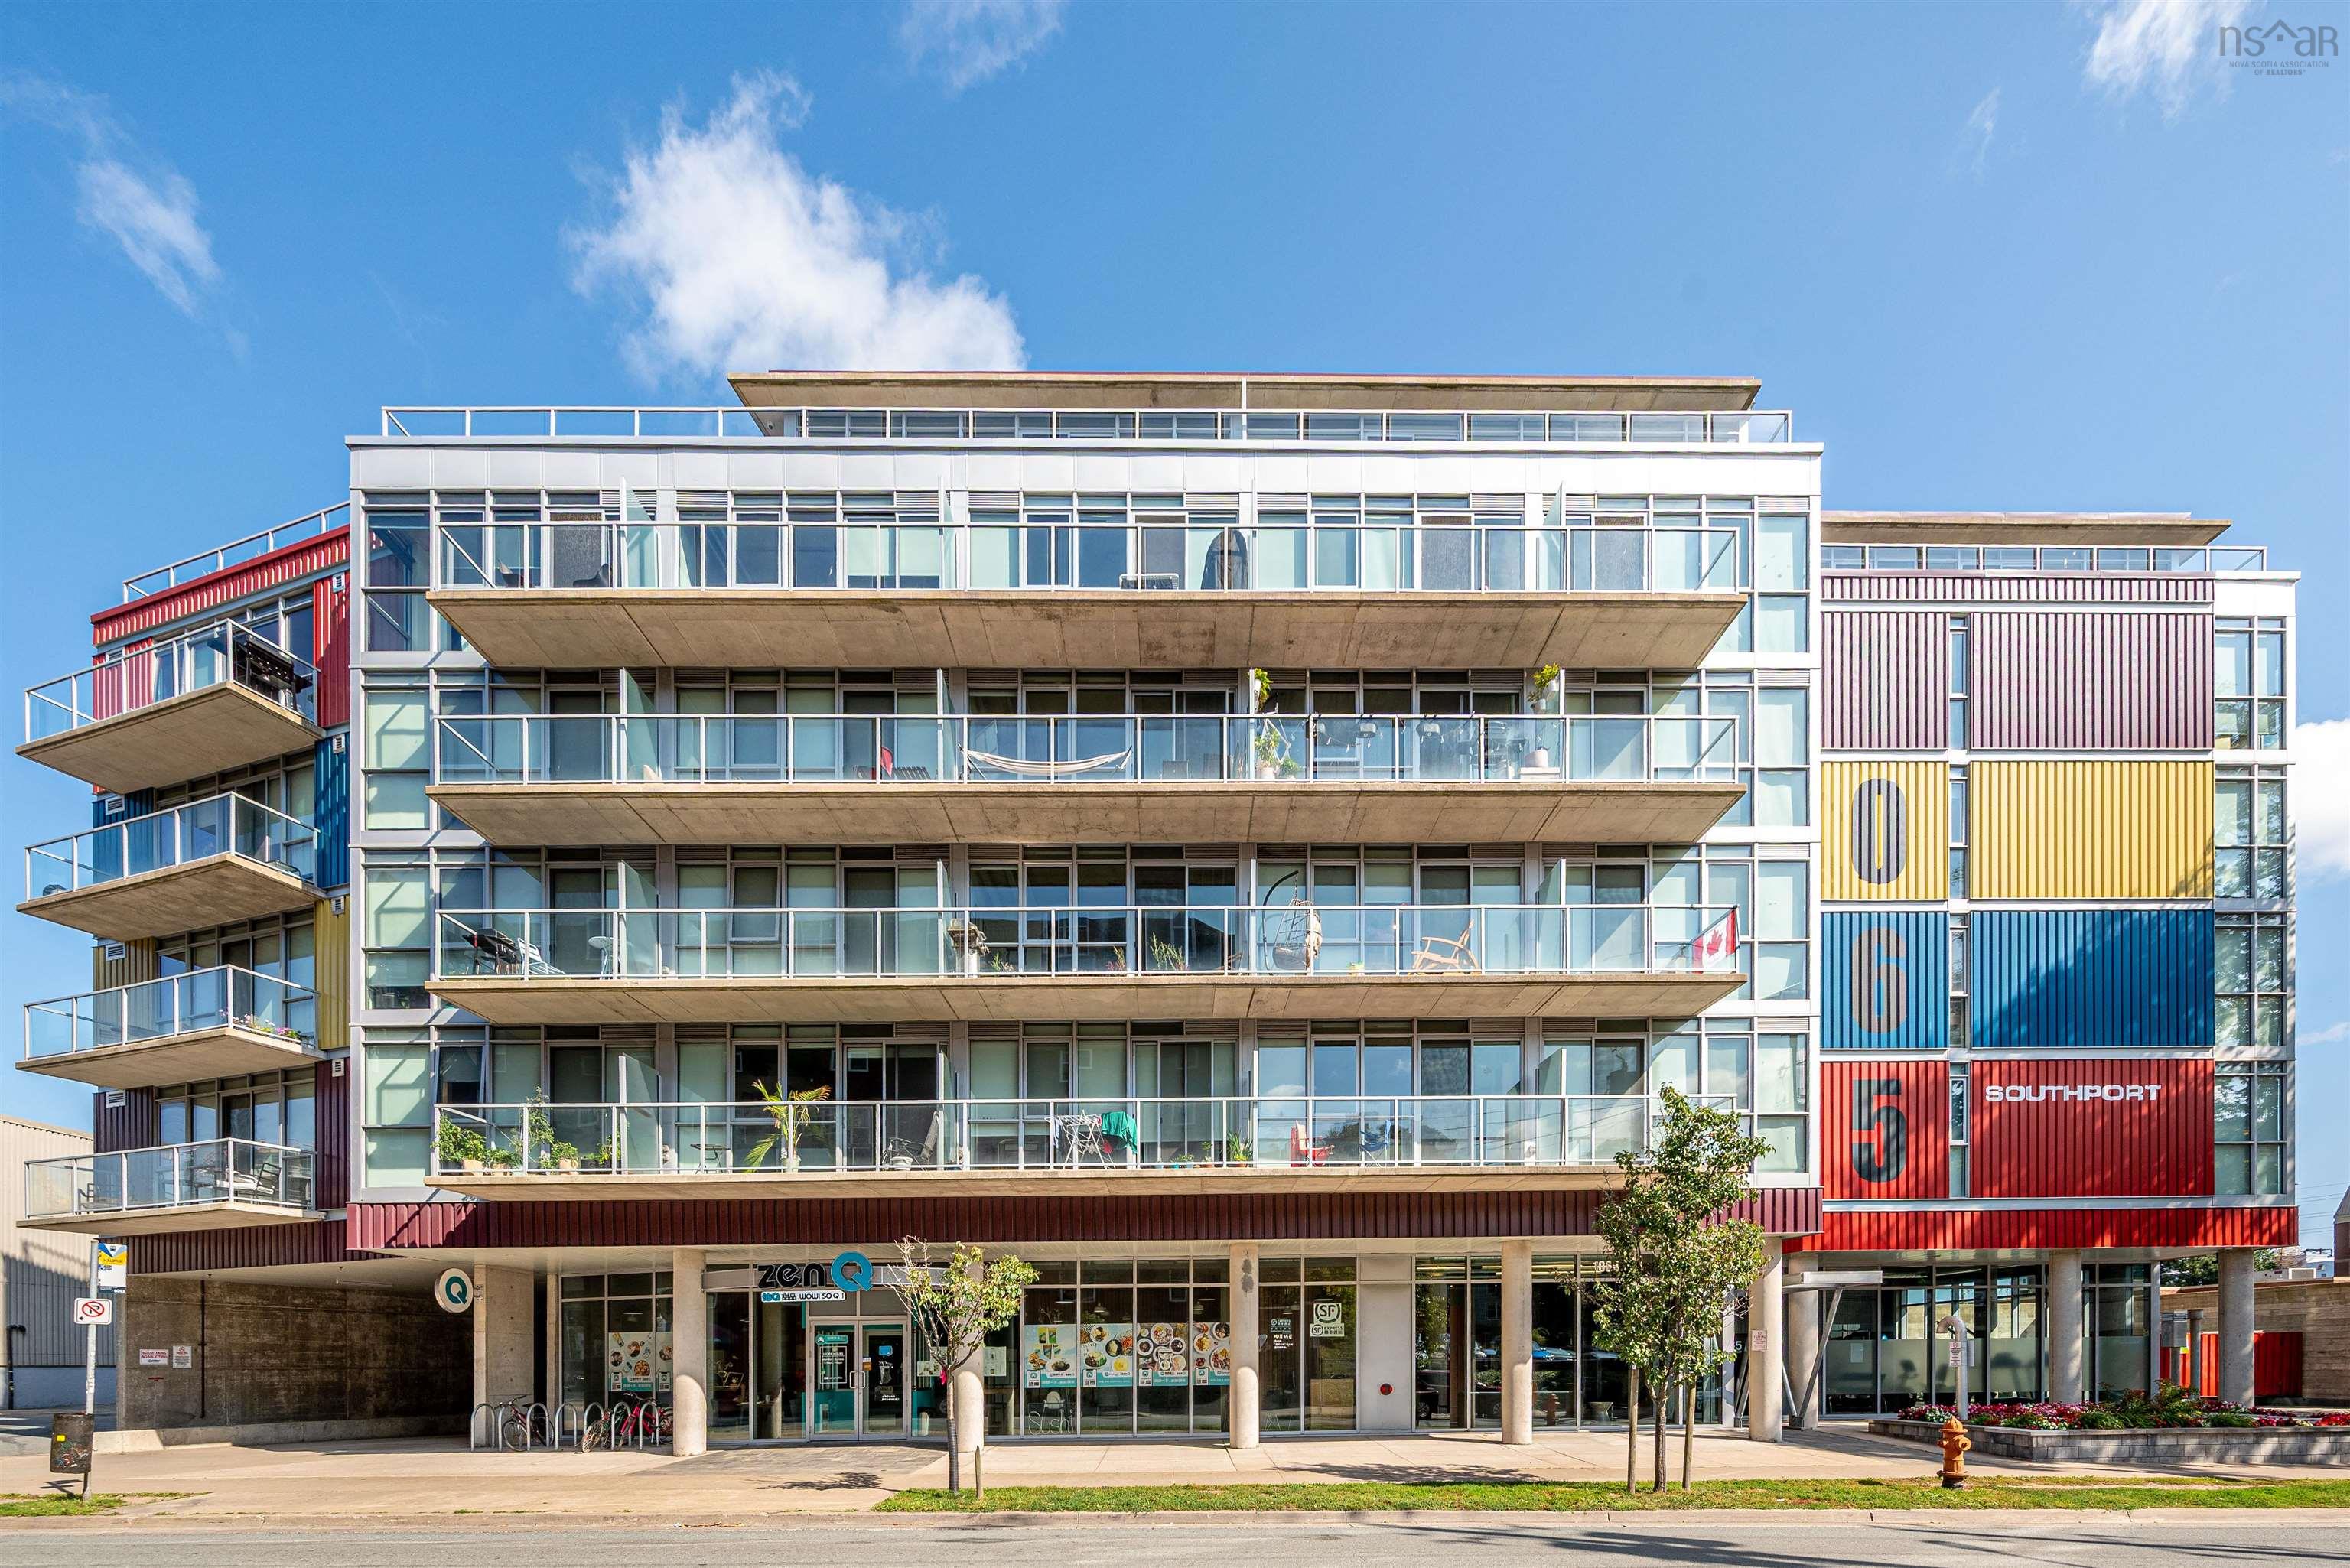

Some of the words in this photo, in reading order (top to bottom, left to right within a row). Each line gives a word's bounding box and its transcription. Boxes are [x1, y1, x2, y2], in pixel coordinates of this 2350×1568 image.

[1984, 1085, 2162, 1102] SOUTHPORT
[445, 1276, 467, 1305] Q
[1028, 1409, 1074, 1436] Sushi
